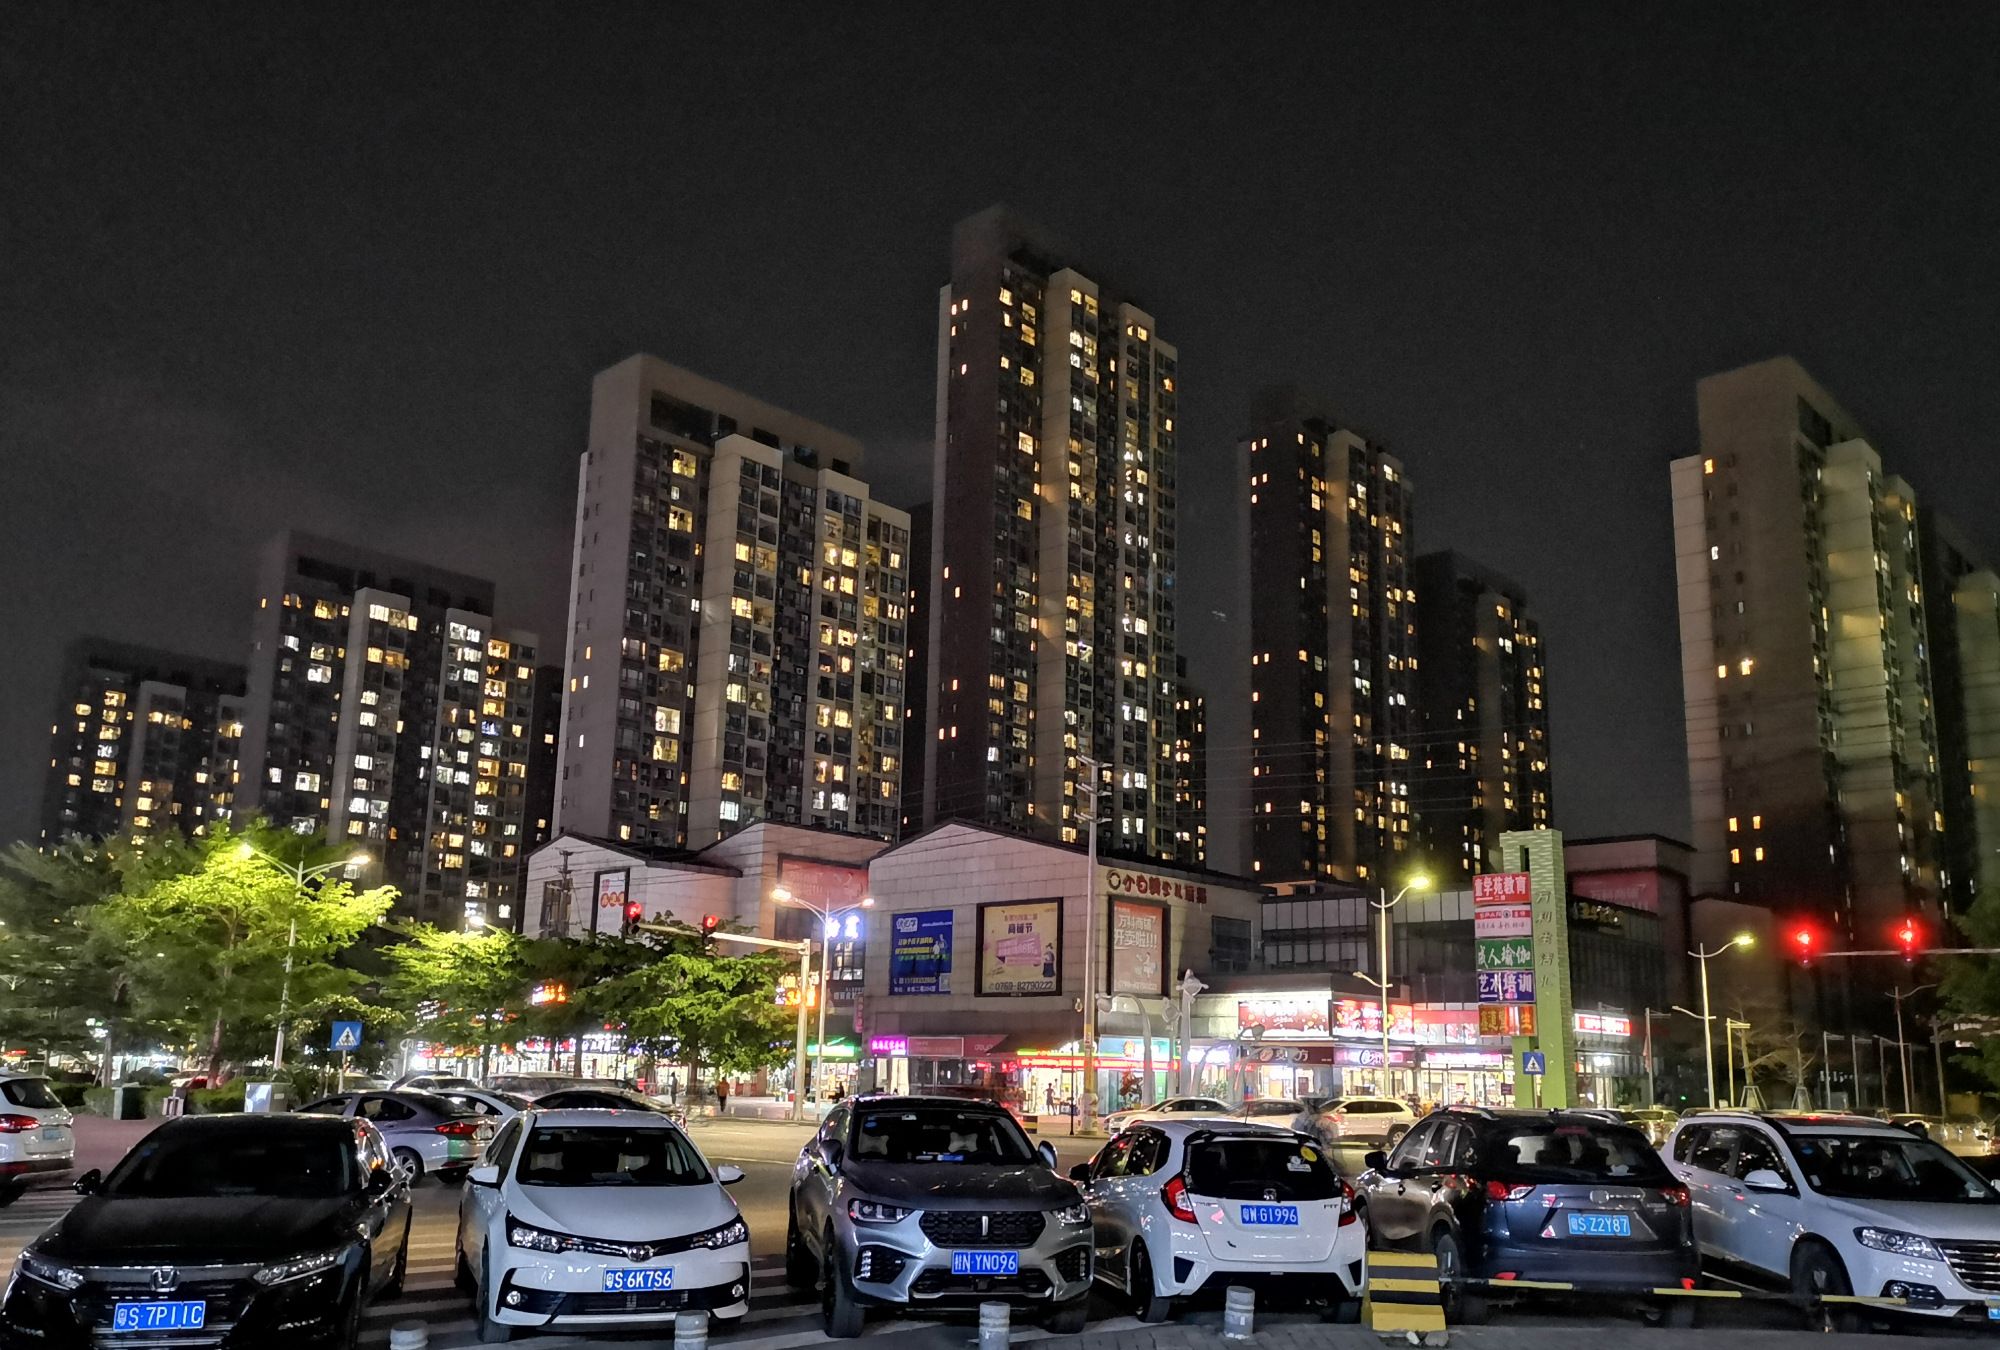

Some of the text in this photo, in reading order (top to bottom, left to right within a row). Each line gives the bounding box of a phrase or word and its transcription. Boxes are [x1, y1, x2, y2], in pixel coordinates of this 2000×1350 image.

[1477, 943, 1531, 969] 成人瑜伽
[1479, 973, 1532, 993] 艺术培训
